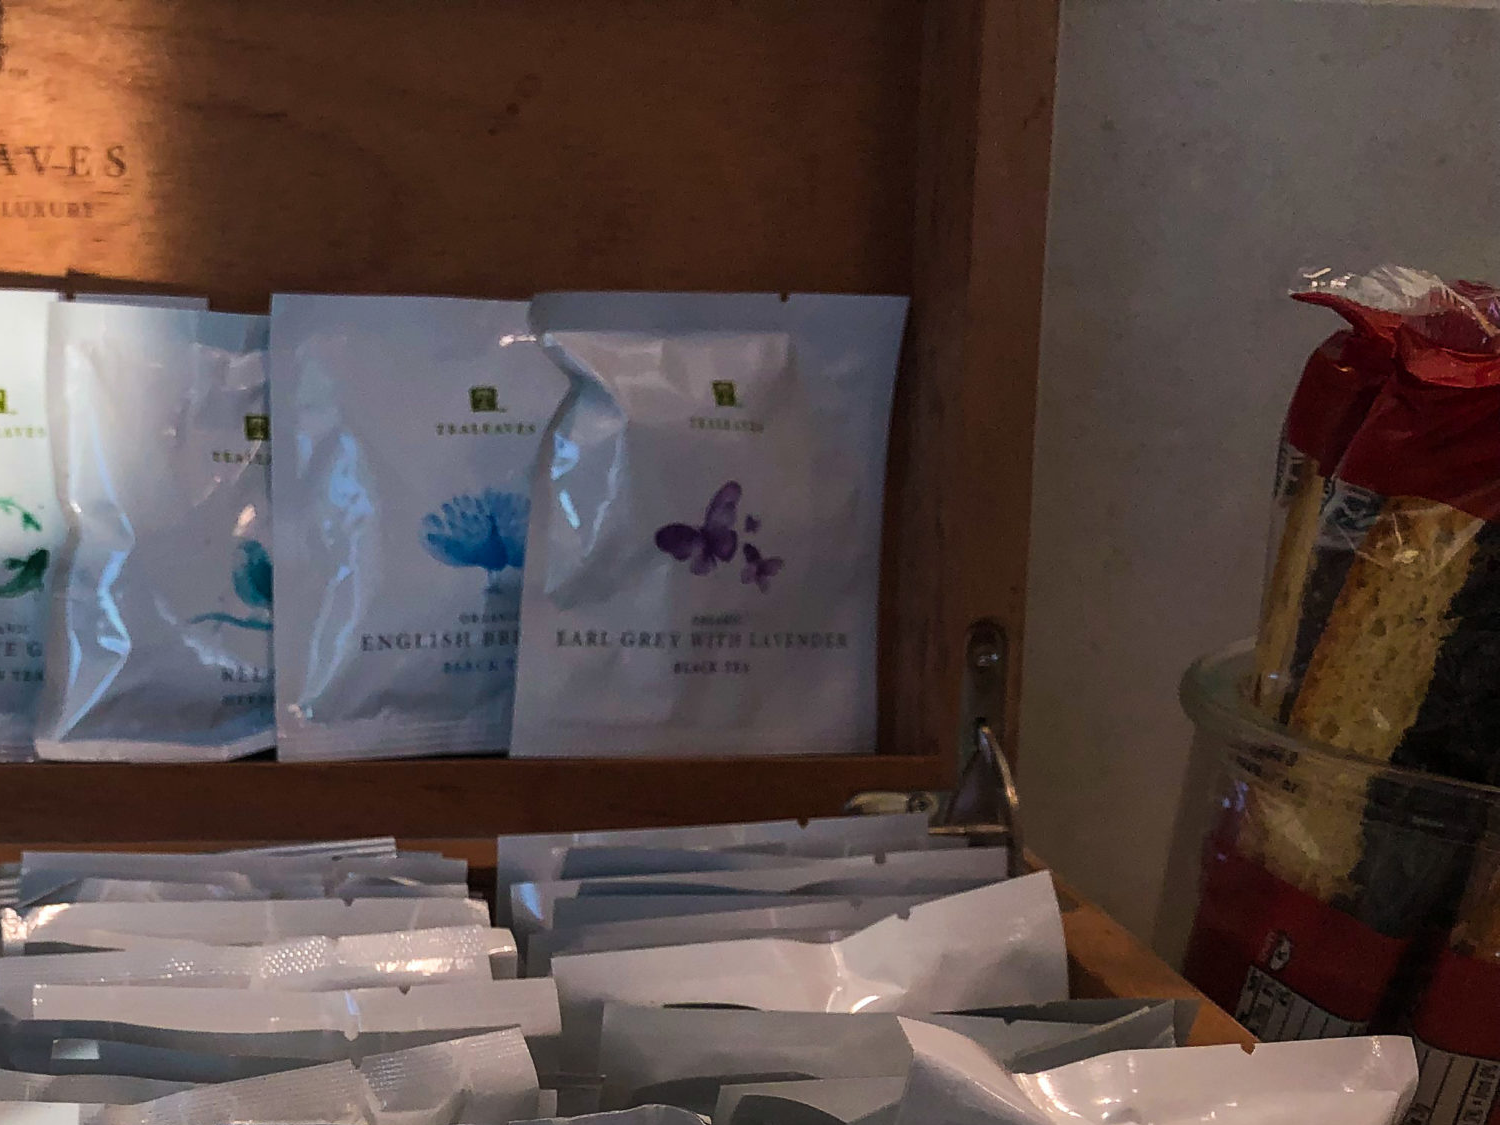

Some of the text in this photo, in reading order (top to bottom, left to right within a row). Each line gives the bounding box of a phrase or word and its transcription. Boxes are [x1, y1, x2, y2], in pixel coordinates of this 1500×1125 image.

[362, 631, 472, 652] ENGLISH
[556, 630, 848, 650] EARL GREY WITH LAVENDER
